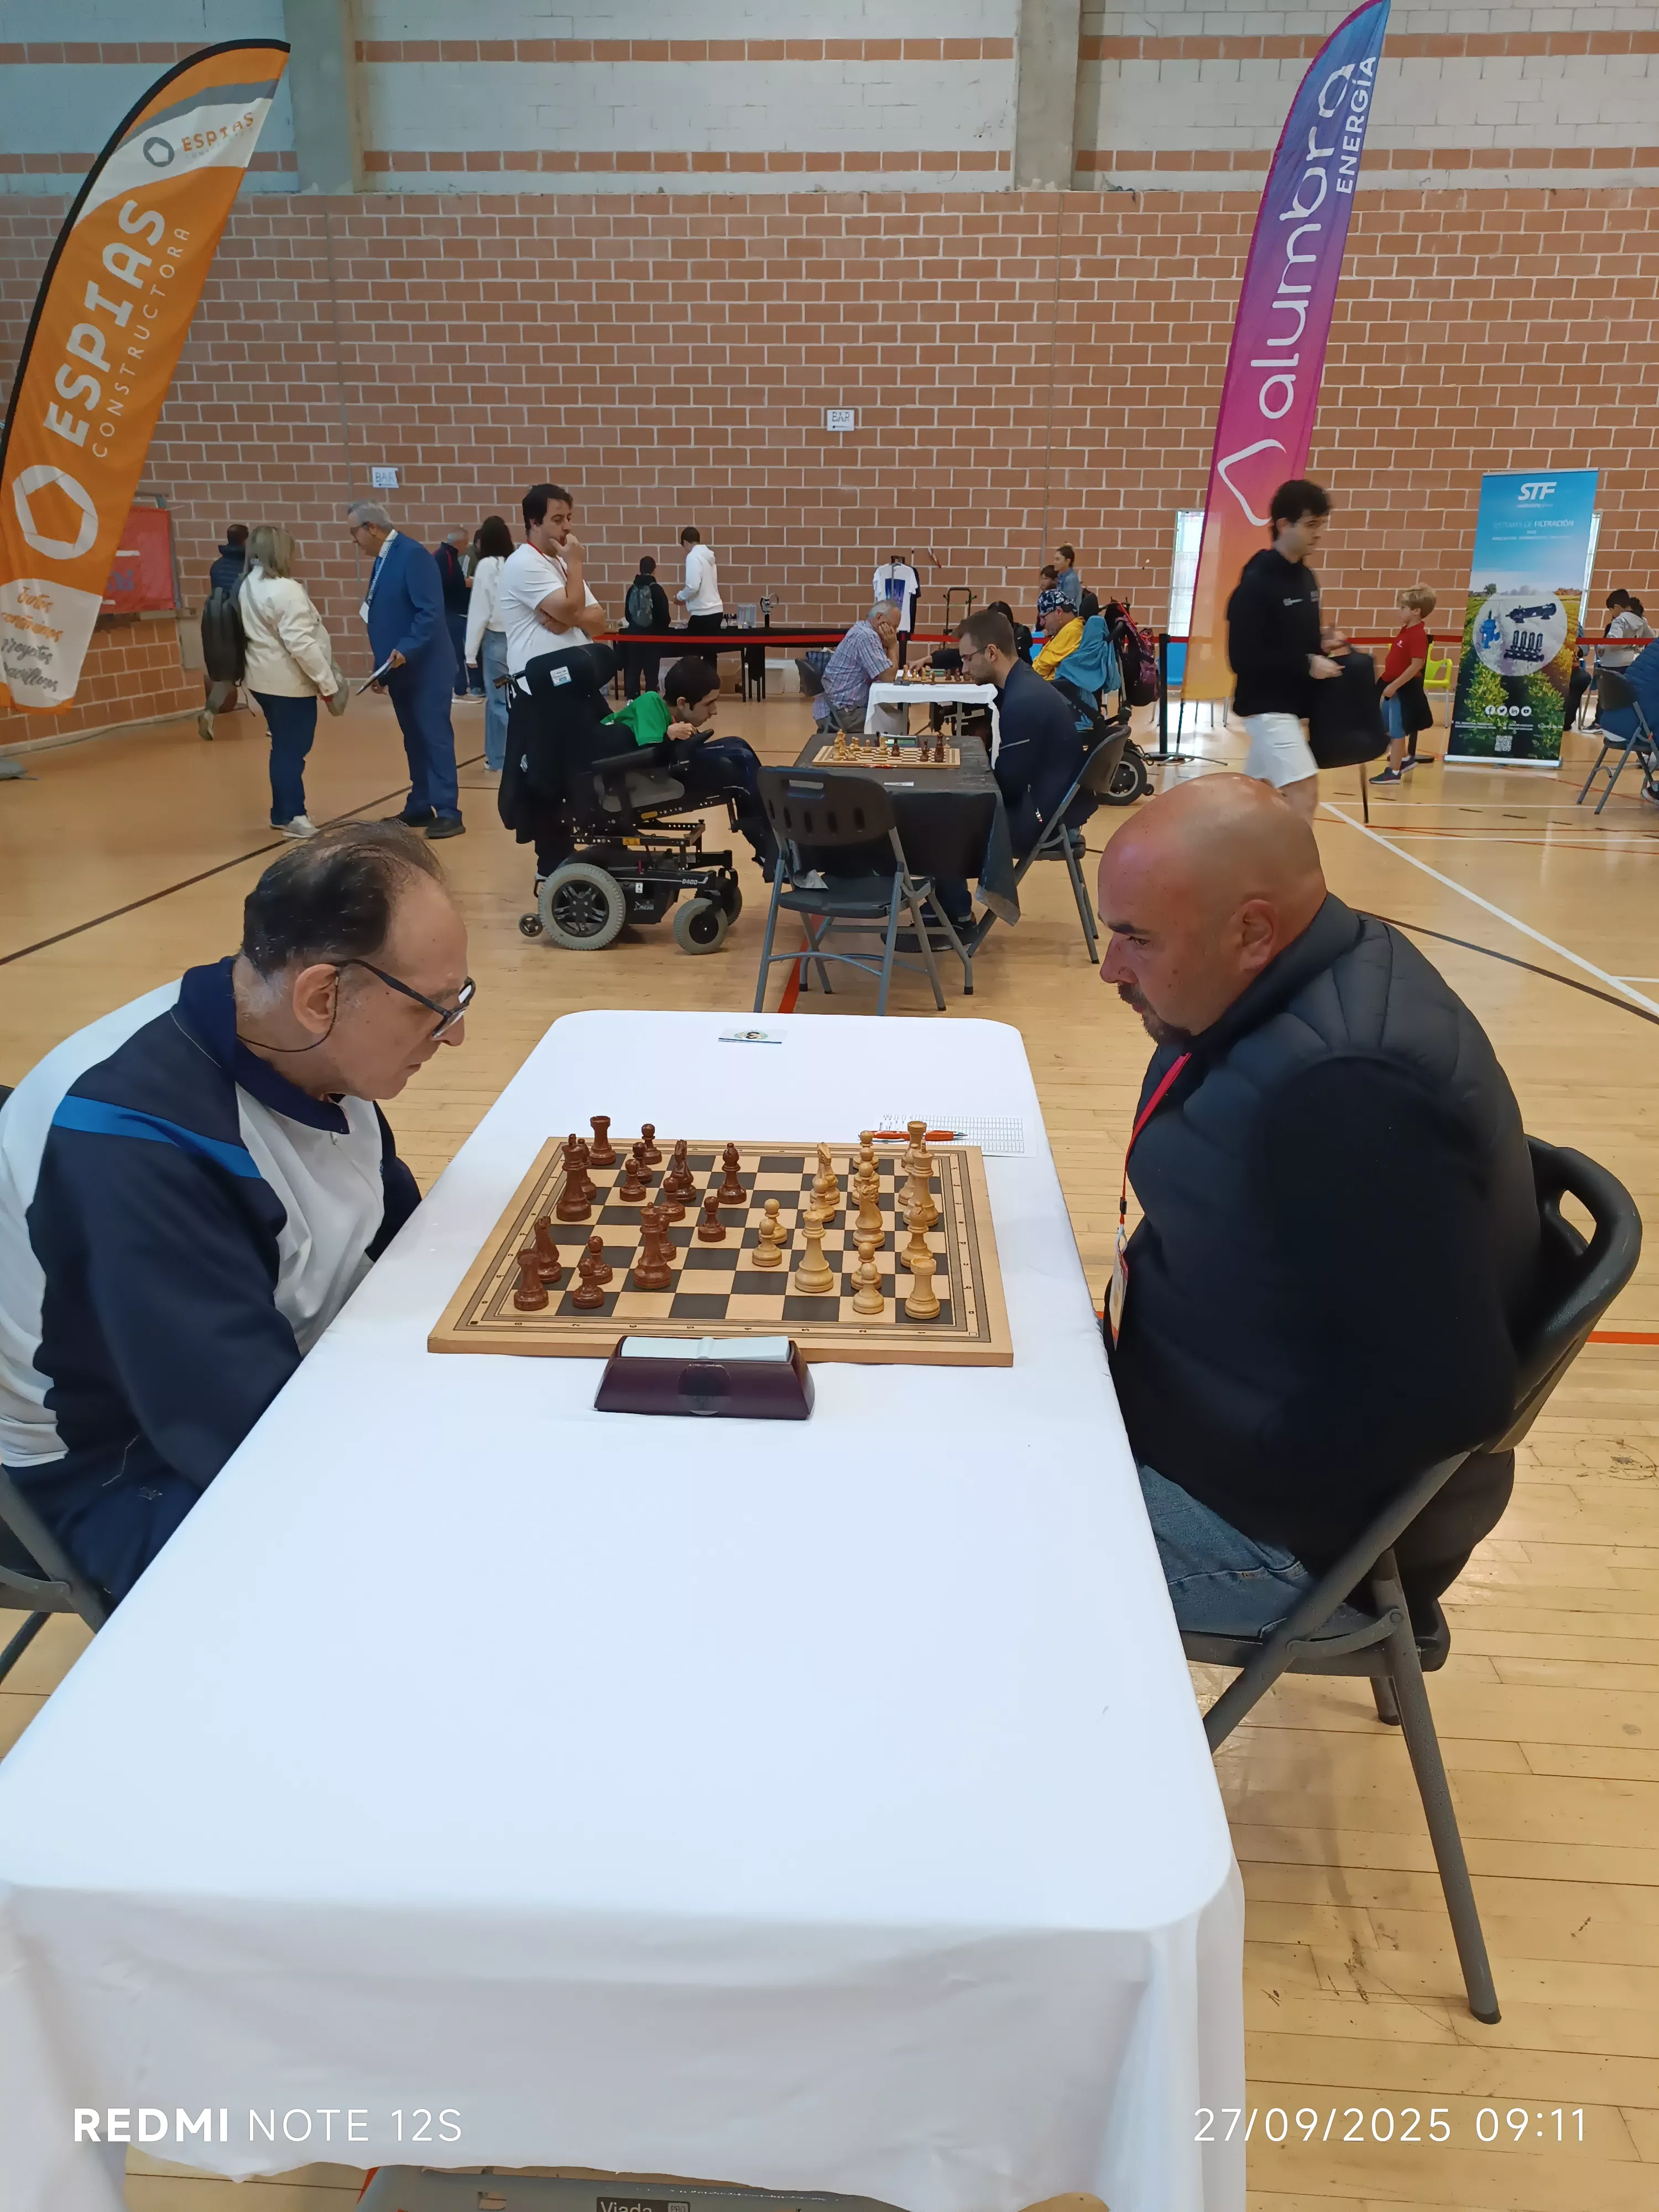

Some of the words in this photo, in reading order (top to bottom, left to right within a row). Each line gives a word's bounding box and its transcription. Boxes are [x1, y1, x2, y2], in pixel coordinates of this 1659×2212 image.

[181, 112, 253, 152] ESPIAS
[1336, 56, 1376, 194] ENERGÍA
[43, 200, 165, 447] ESPIAS
[92, 228, 190, 458] CONSTRUCTORA
[832, 411, 850, 422] BAR
[375, 471, 394, 483] BAR
[1517, 482, 1557, 500] STF
